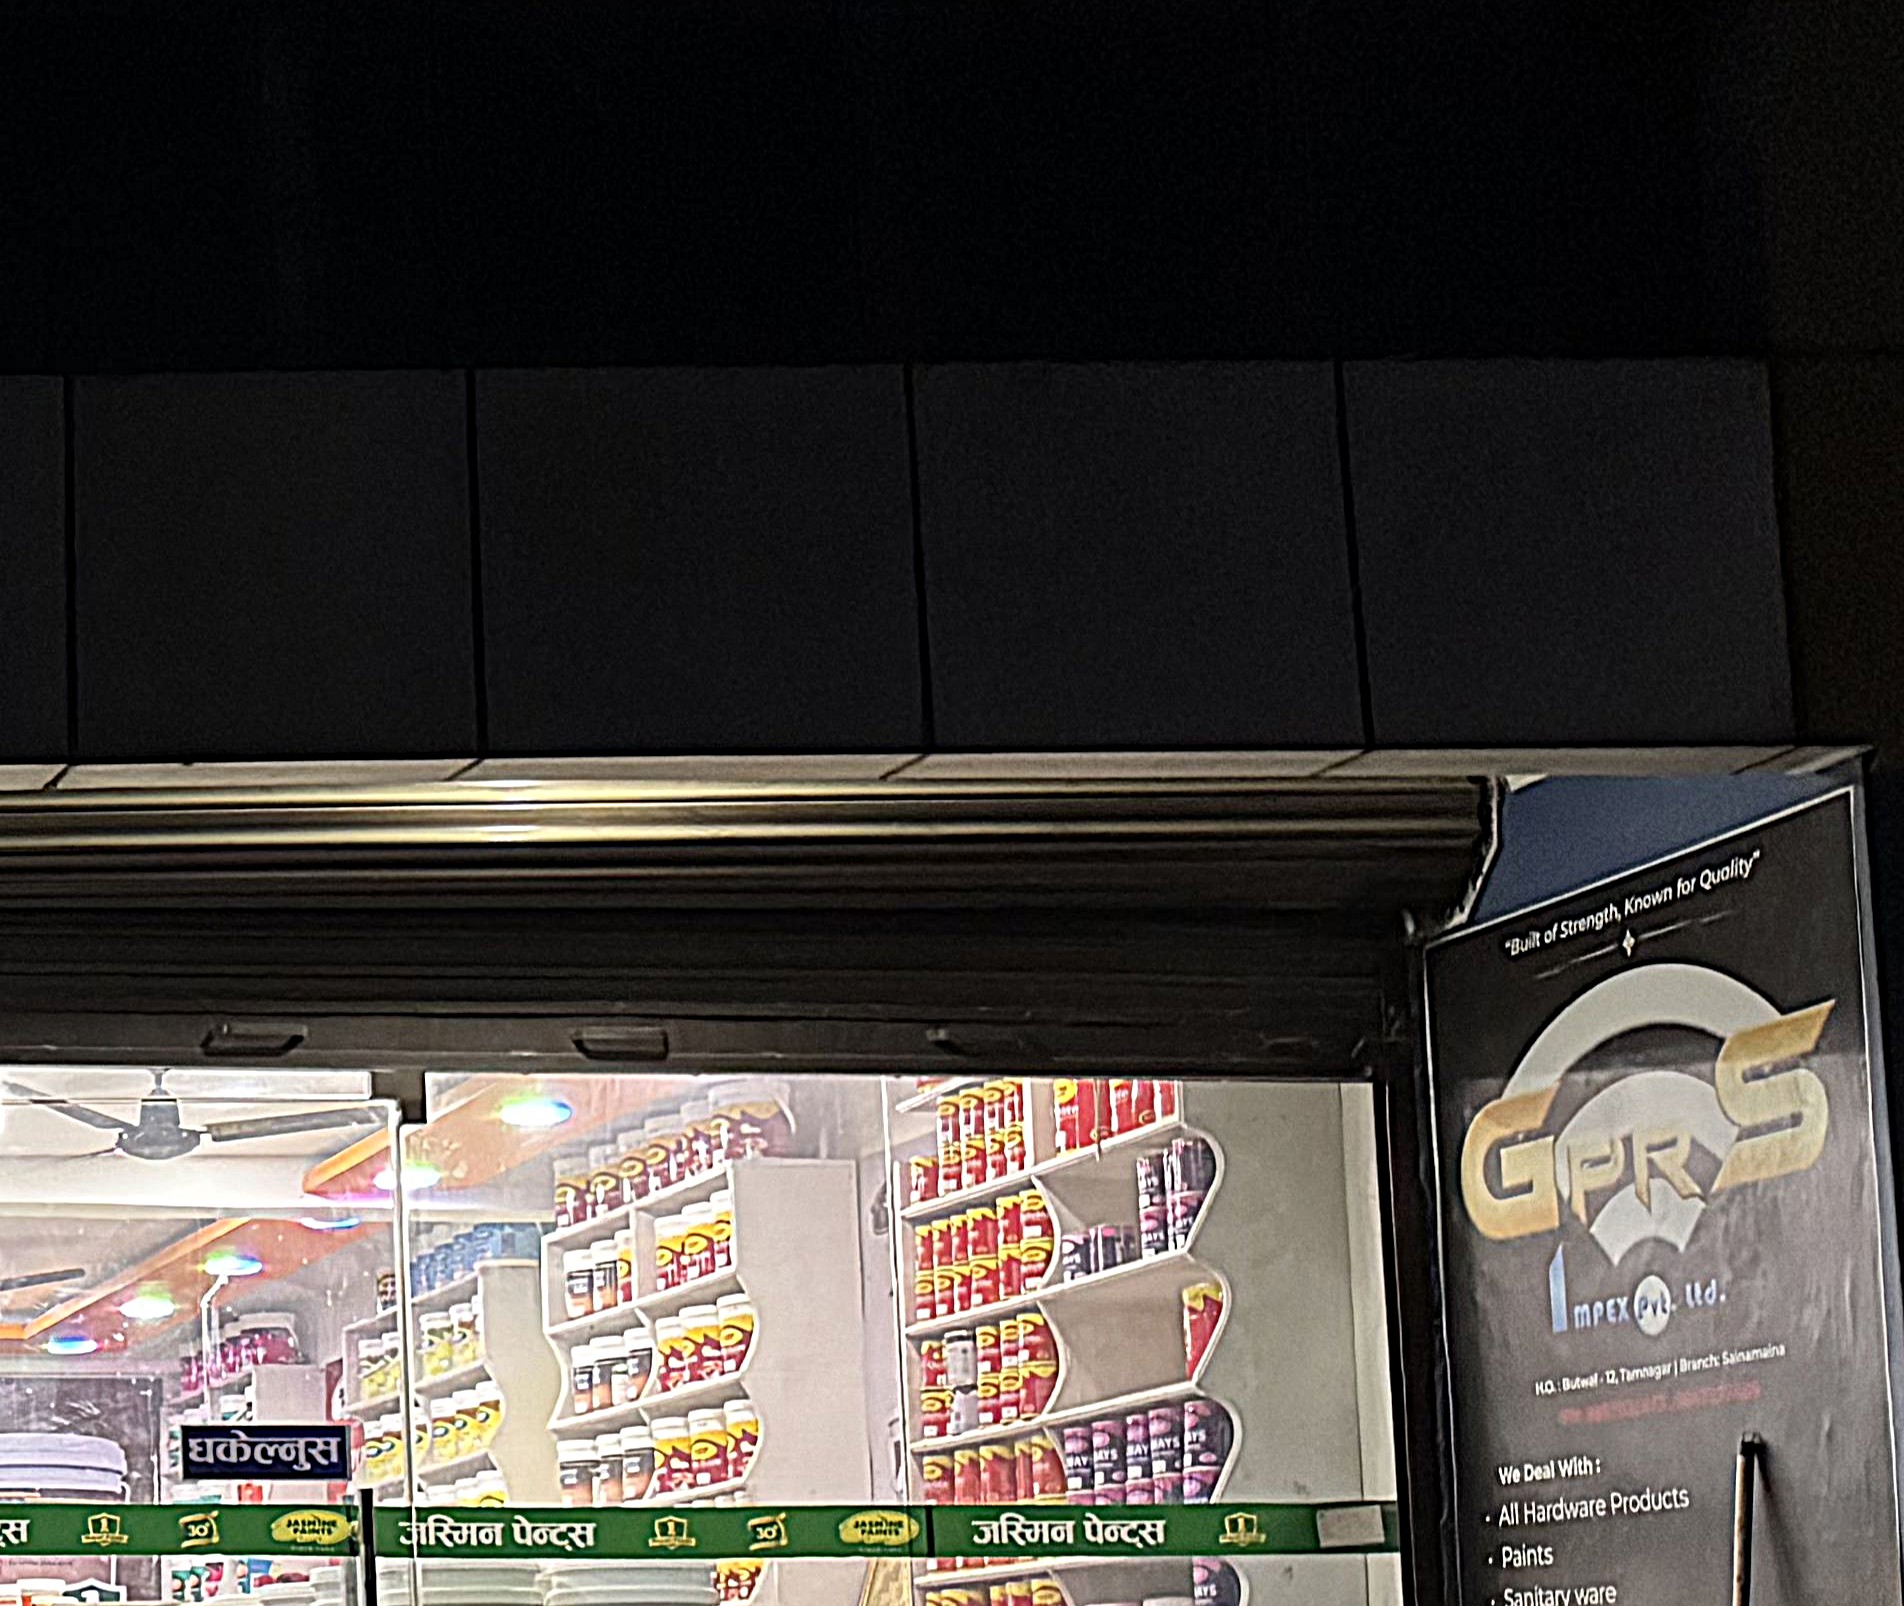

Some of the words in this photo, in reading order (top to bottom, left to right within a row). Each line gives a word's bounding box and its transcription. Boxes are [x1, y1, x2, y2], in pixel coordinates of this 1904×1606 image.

[1544, 923, 1558, 943] of
[1560, 903, 1621, 939] Strength,
[1624, 886, 1672, 918] Known
[1676, 877, 1697, 899] for
[1498, 1466, 1521, 1486] We
[1523, 1460, 1556, 1483] Deal
[1558, 1458, 1594, 1479] With
[1498, 1504, 1519, 1527] All
[1523, 1495, 1607, 1526] Hardware
[1610, 1487, 1690, 1519] Products
[286, 1518, 338, 1529] JASMINE
[292, 1527, 334, 1536] PAINTS
[853, 1520, 905, 1529] JASMINE
[860, 1528, 900, 1537] PAINTS
[1501, 1545, 1554, 1569] Paints
[1574, 1583, 1617, 1606] ware
